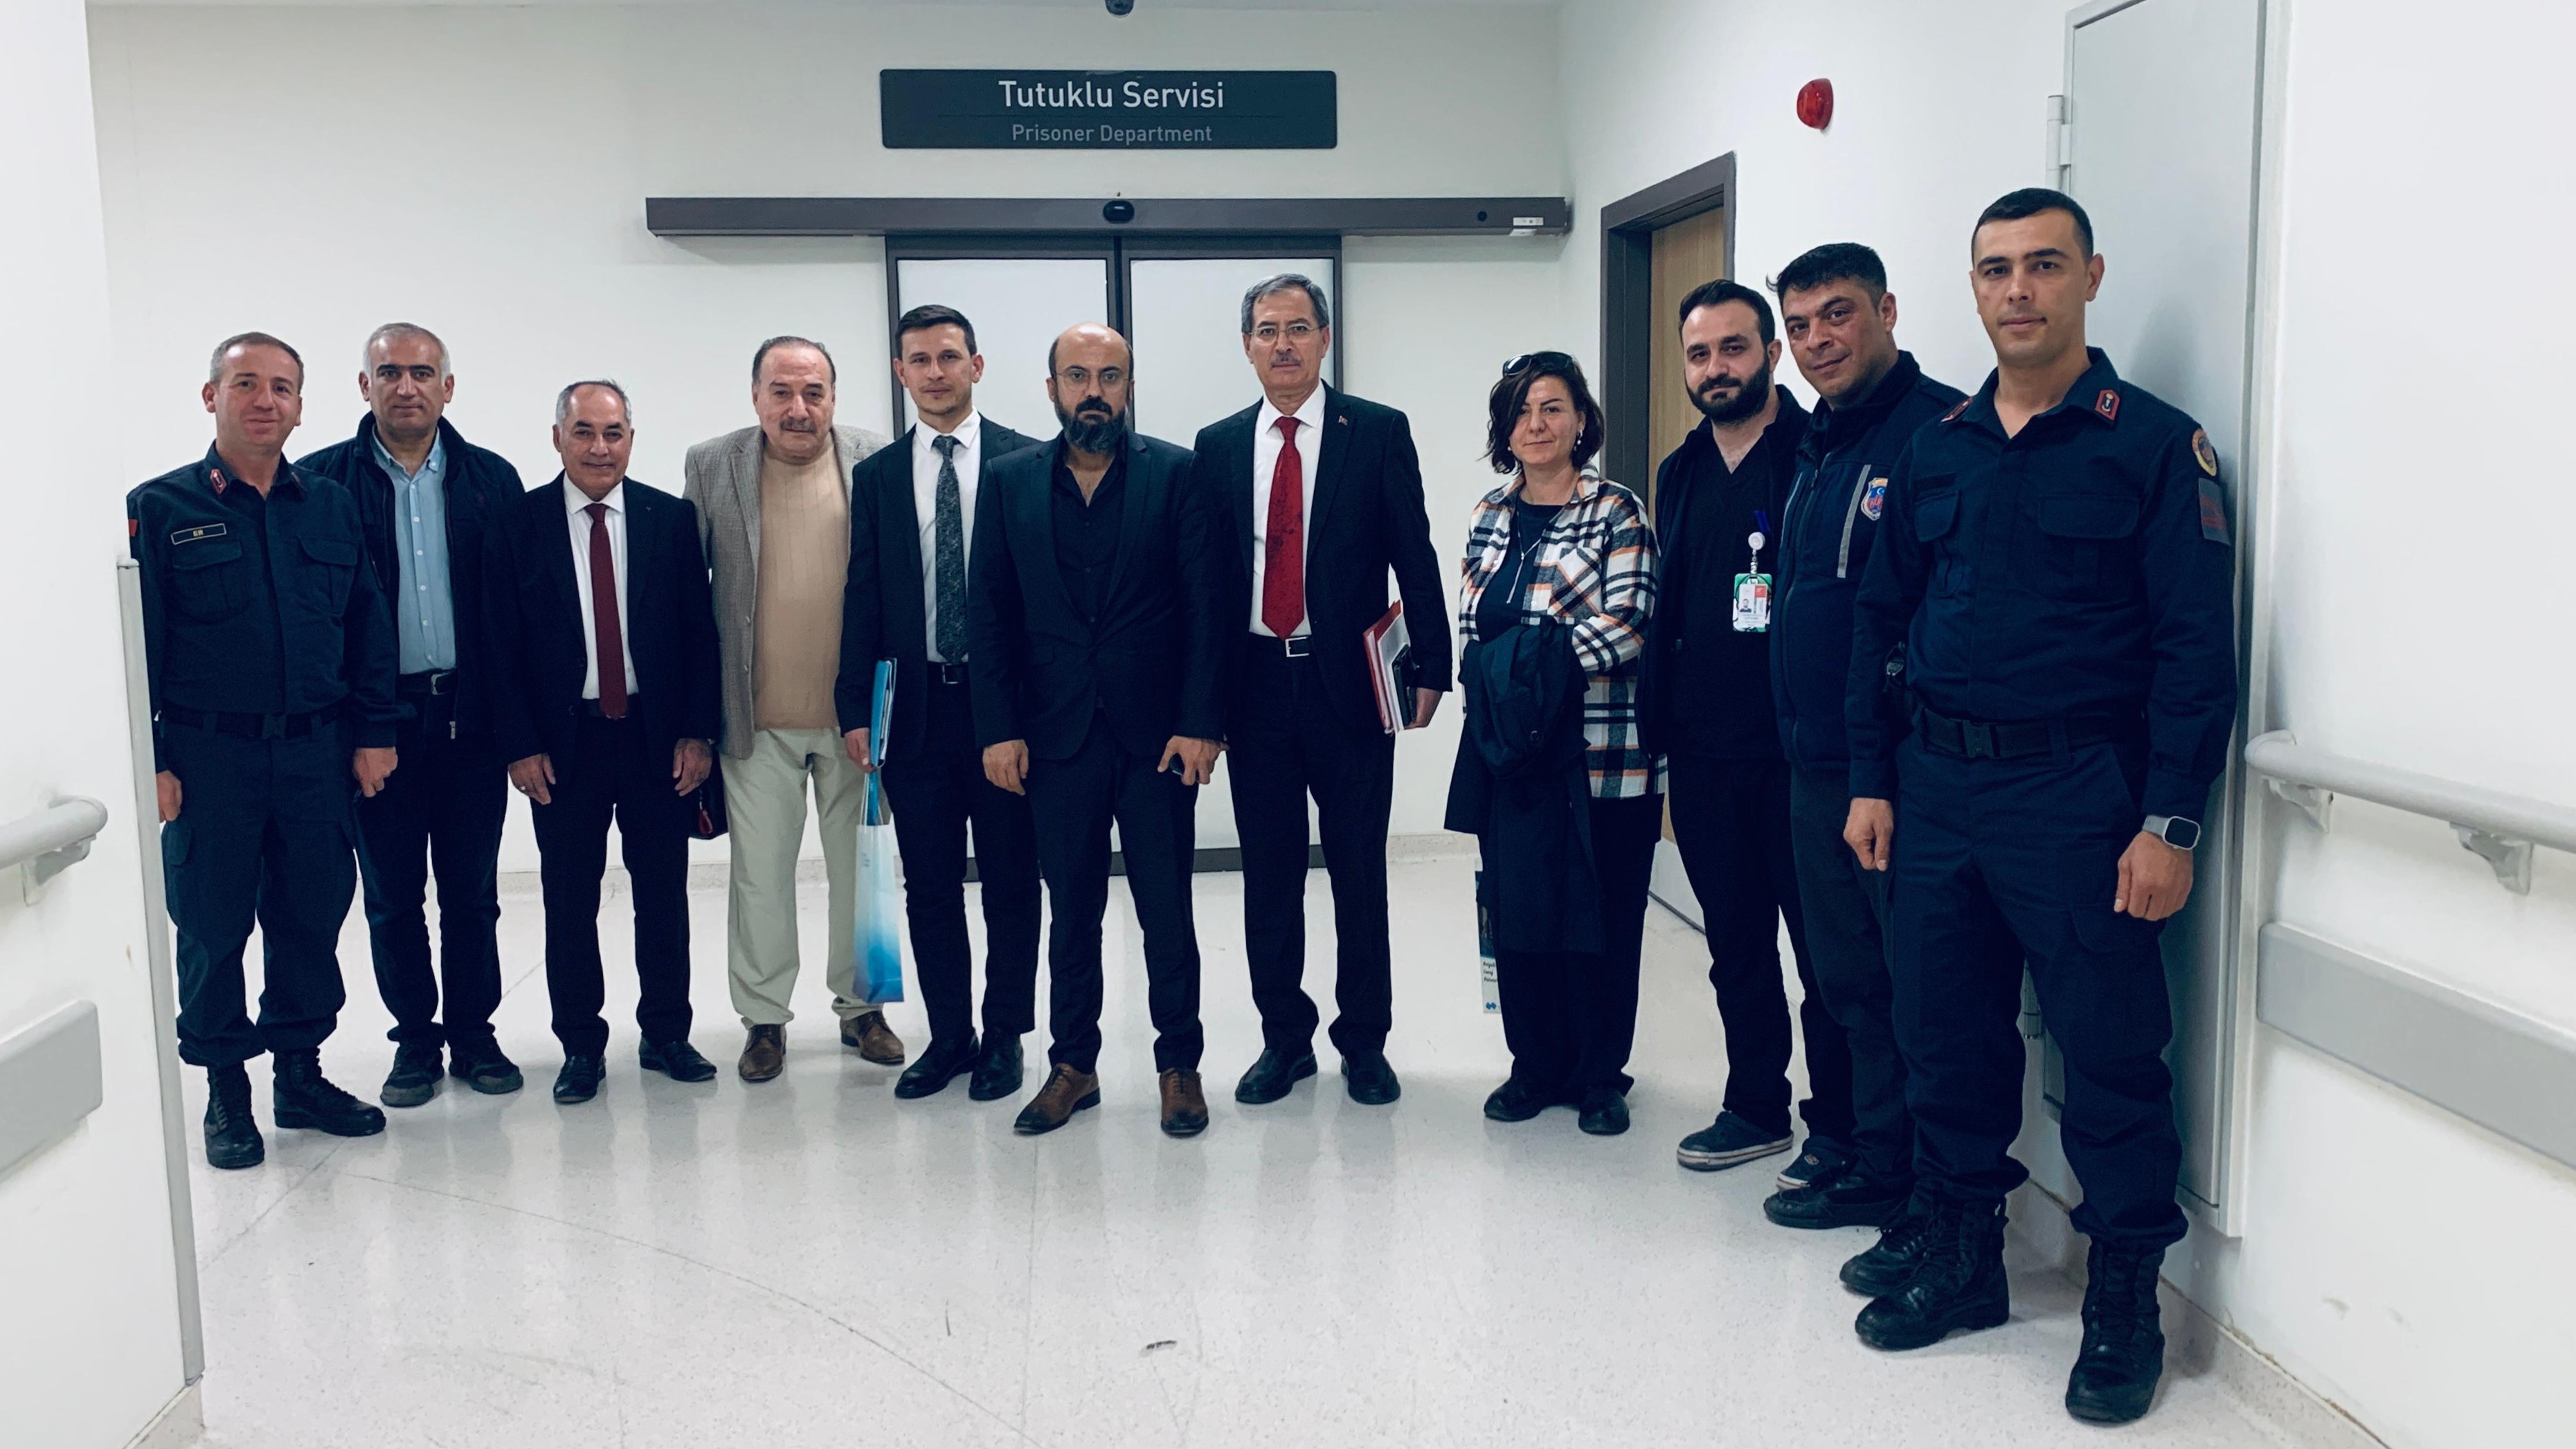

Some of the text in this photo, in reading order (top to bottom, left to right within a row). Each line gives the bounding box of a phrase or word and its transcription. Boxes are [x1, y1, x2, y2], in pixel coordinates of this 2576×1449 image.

[998, 80, 1224, 108] Tutuklu Servisi
[1012, 124, 1213, 146] Prisoner Department
